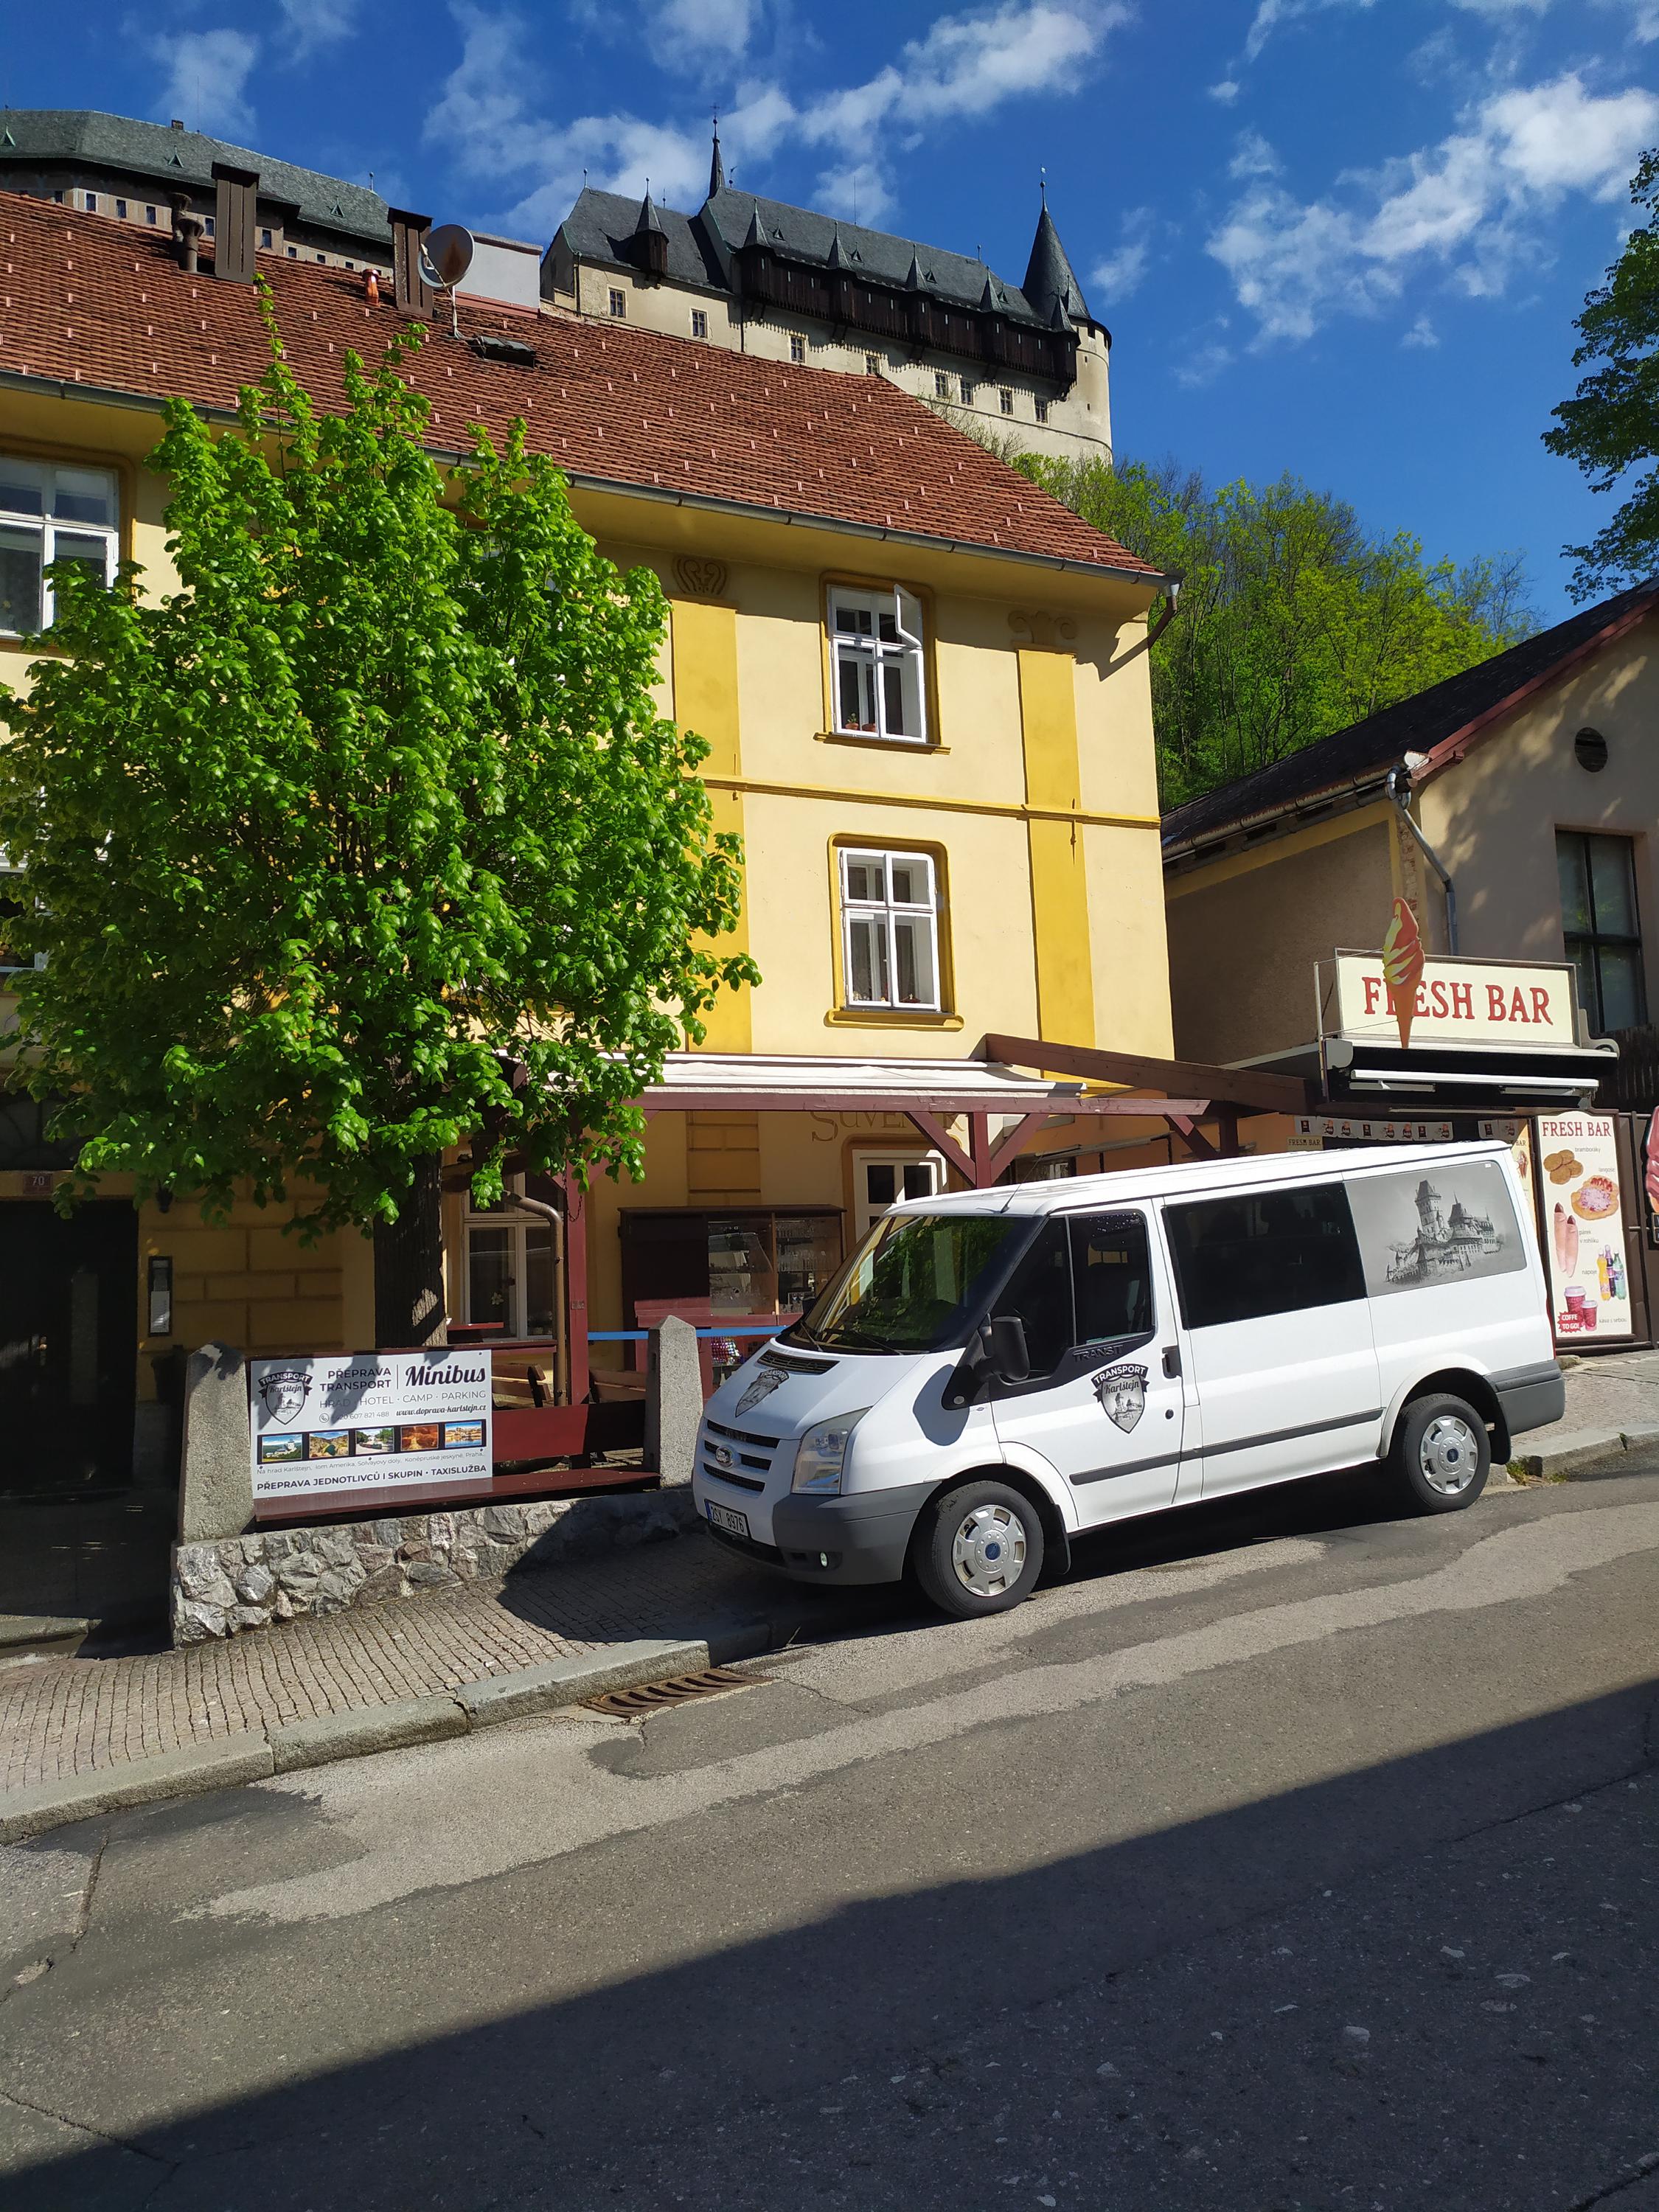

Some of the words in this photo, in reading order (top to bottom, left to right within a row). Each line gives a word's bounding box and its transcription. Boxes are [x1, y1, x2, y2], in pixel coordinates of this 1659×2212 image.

[1485, 984, 1554, 1026] BAR
[1542, 1121, 1583, 1137] FRESH
[1587, 1122, 1612, 1137] BAR
[32, 1175, 45, 1186] 70
[260, 1373, 310, 1384] TRANSPORT
[328, 1367, 392, 1380] PŘEPRAVA
[406, 1365, 486, 1387] Minibus
[1094, 1366, 1145, 1384] TRANSPORT
[320, 1380, 392, 1391] TRANSPORT
[1105, 1380, 1140, 1394] Karlštejn
[319, 1398, 349, 1408] HRAD
[360, 1396, 394, 1406] HOTEL
[403, 1394, 433, 1403] CAMP
[442, 1390, 487, 1400] PARKING
[257, 1479, 310, 1491] PŘEPRAVA
[313, 1471, 380, 1486] JEDNOTLIVCŮ
[388, 1470, 422, 1480] SKUPIN
[431, 1464, 487, 1476] TAXISLUŽBA
[726, 1512, 744, 1533] 8976
